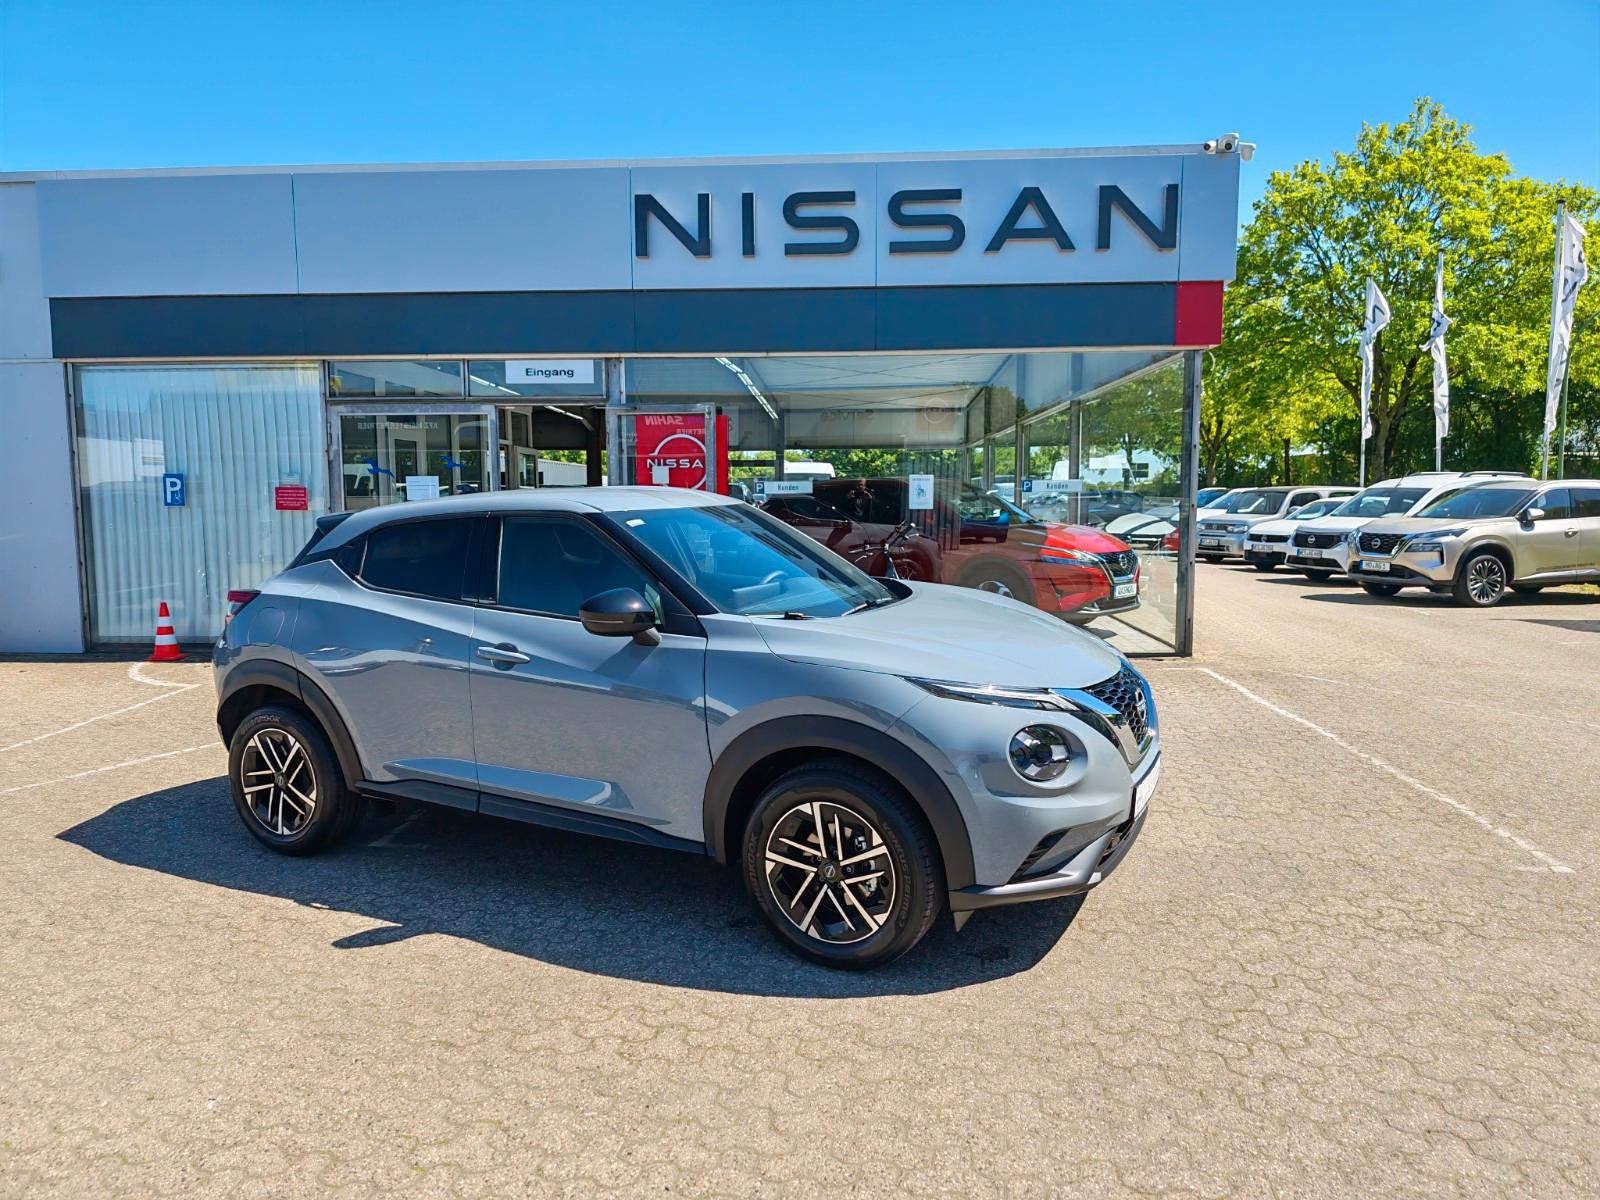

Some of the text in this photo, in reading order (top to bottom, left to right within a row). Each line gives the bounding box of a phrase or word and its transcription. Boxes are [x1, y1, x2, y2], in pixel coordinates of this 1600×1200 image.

[634, 183, 1179, 258] NISSAN
[525, 368, 574, 378] Eingang
[647, 459, 704, 469] NISSA
[166, 477, 182, 503] P
[756, 483, 763, 493] P
[1023, 481, 1031, 491] P
